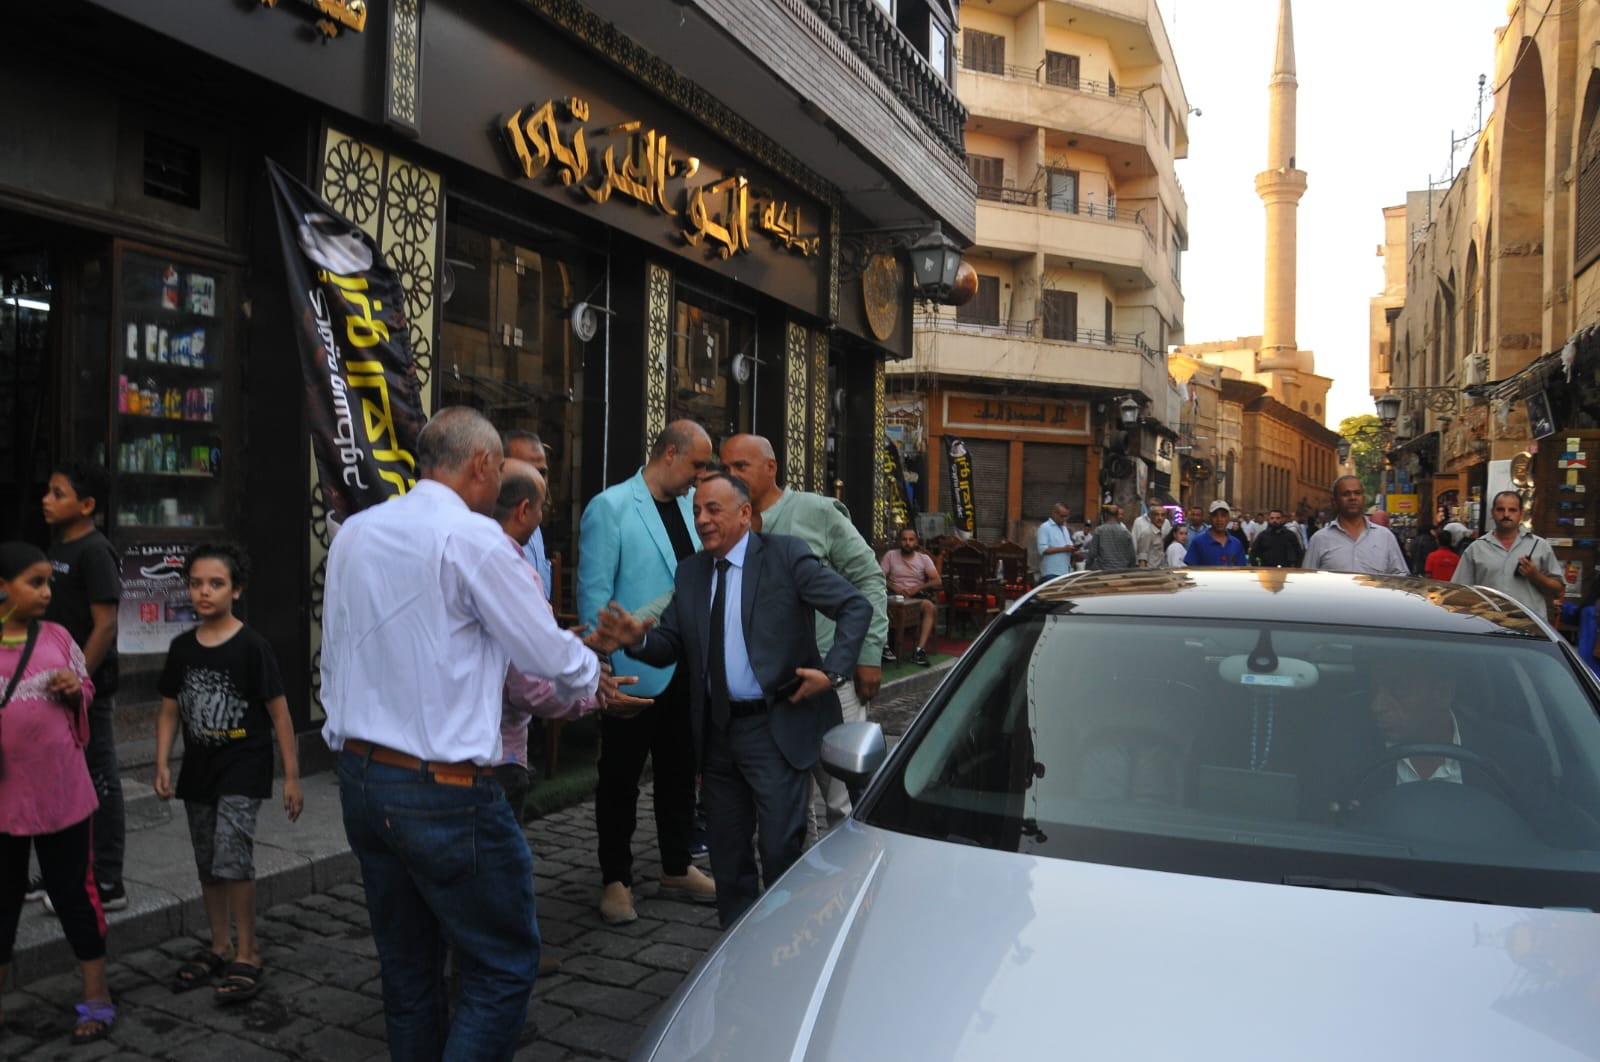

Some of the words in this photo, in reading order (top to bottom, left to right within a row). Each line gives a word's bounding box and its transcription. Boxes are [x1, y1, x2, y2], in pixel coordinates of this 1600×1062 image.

[308, 287, 341, 372] كافيه
[330, 373, 369, 491] وسطوح
[346, 360, 418, 500] العرب
